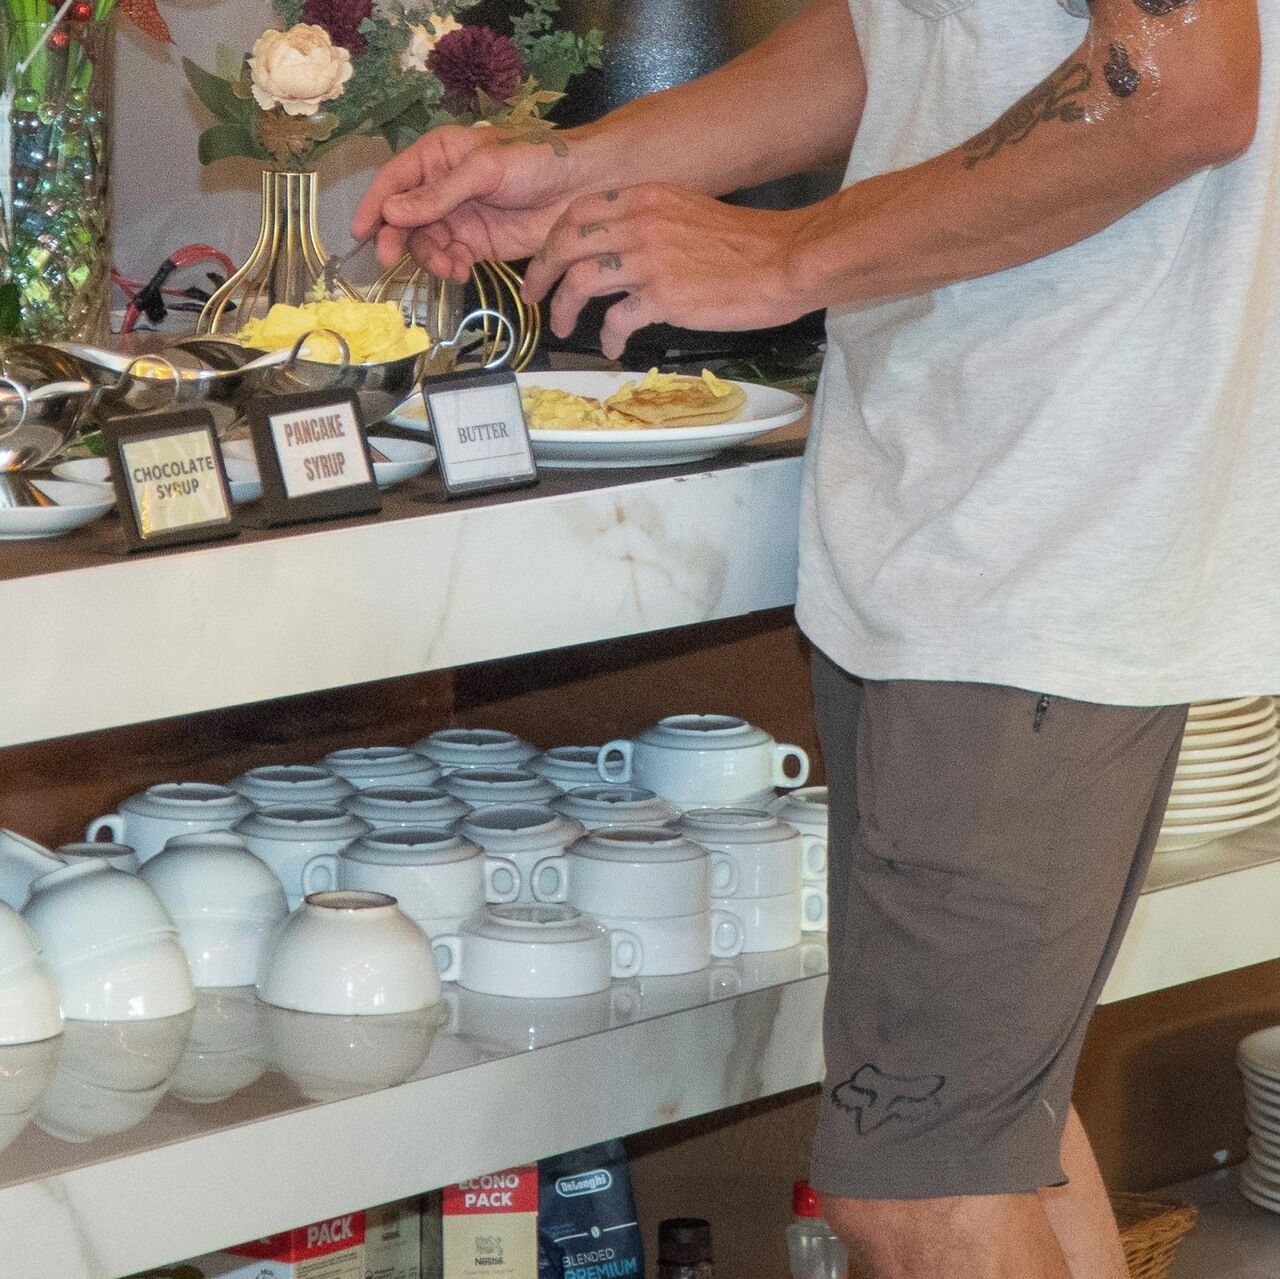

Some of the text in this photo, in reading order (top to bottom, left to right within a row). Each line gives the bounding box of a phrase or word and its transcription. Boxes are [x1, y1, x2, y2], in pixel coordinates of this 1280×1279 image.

[283, 413, 346, 447] PANCAKE
[458, 421, 510, 445] BUTTER
[133, 454, 215, 484] CHOCOLATE
[303, 451, 346, 481] SYRUP
[156, 478, 200, 501] SYRUP
[464, 1191, 513, 1208] PACK
[307, 1216, 353, 1248] PACK
[562, 1248, 615, 1268] BLENDED
